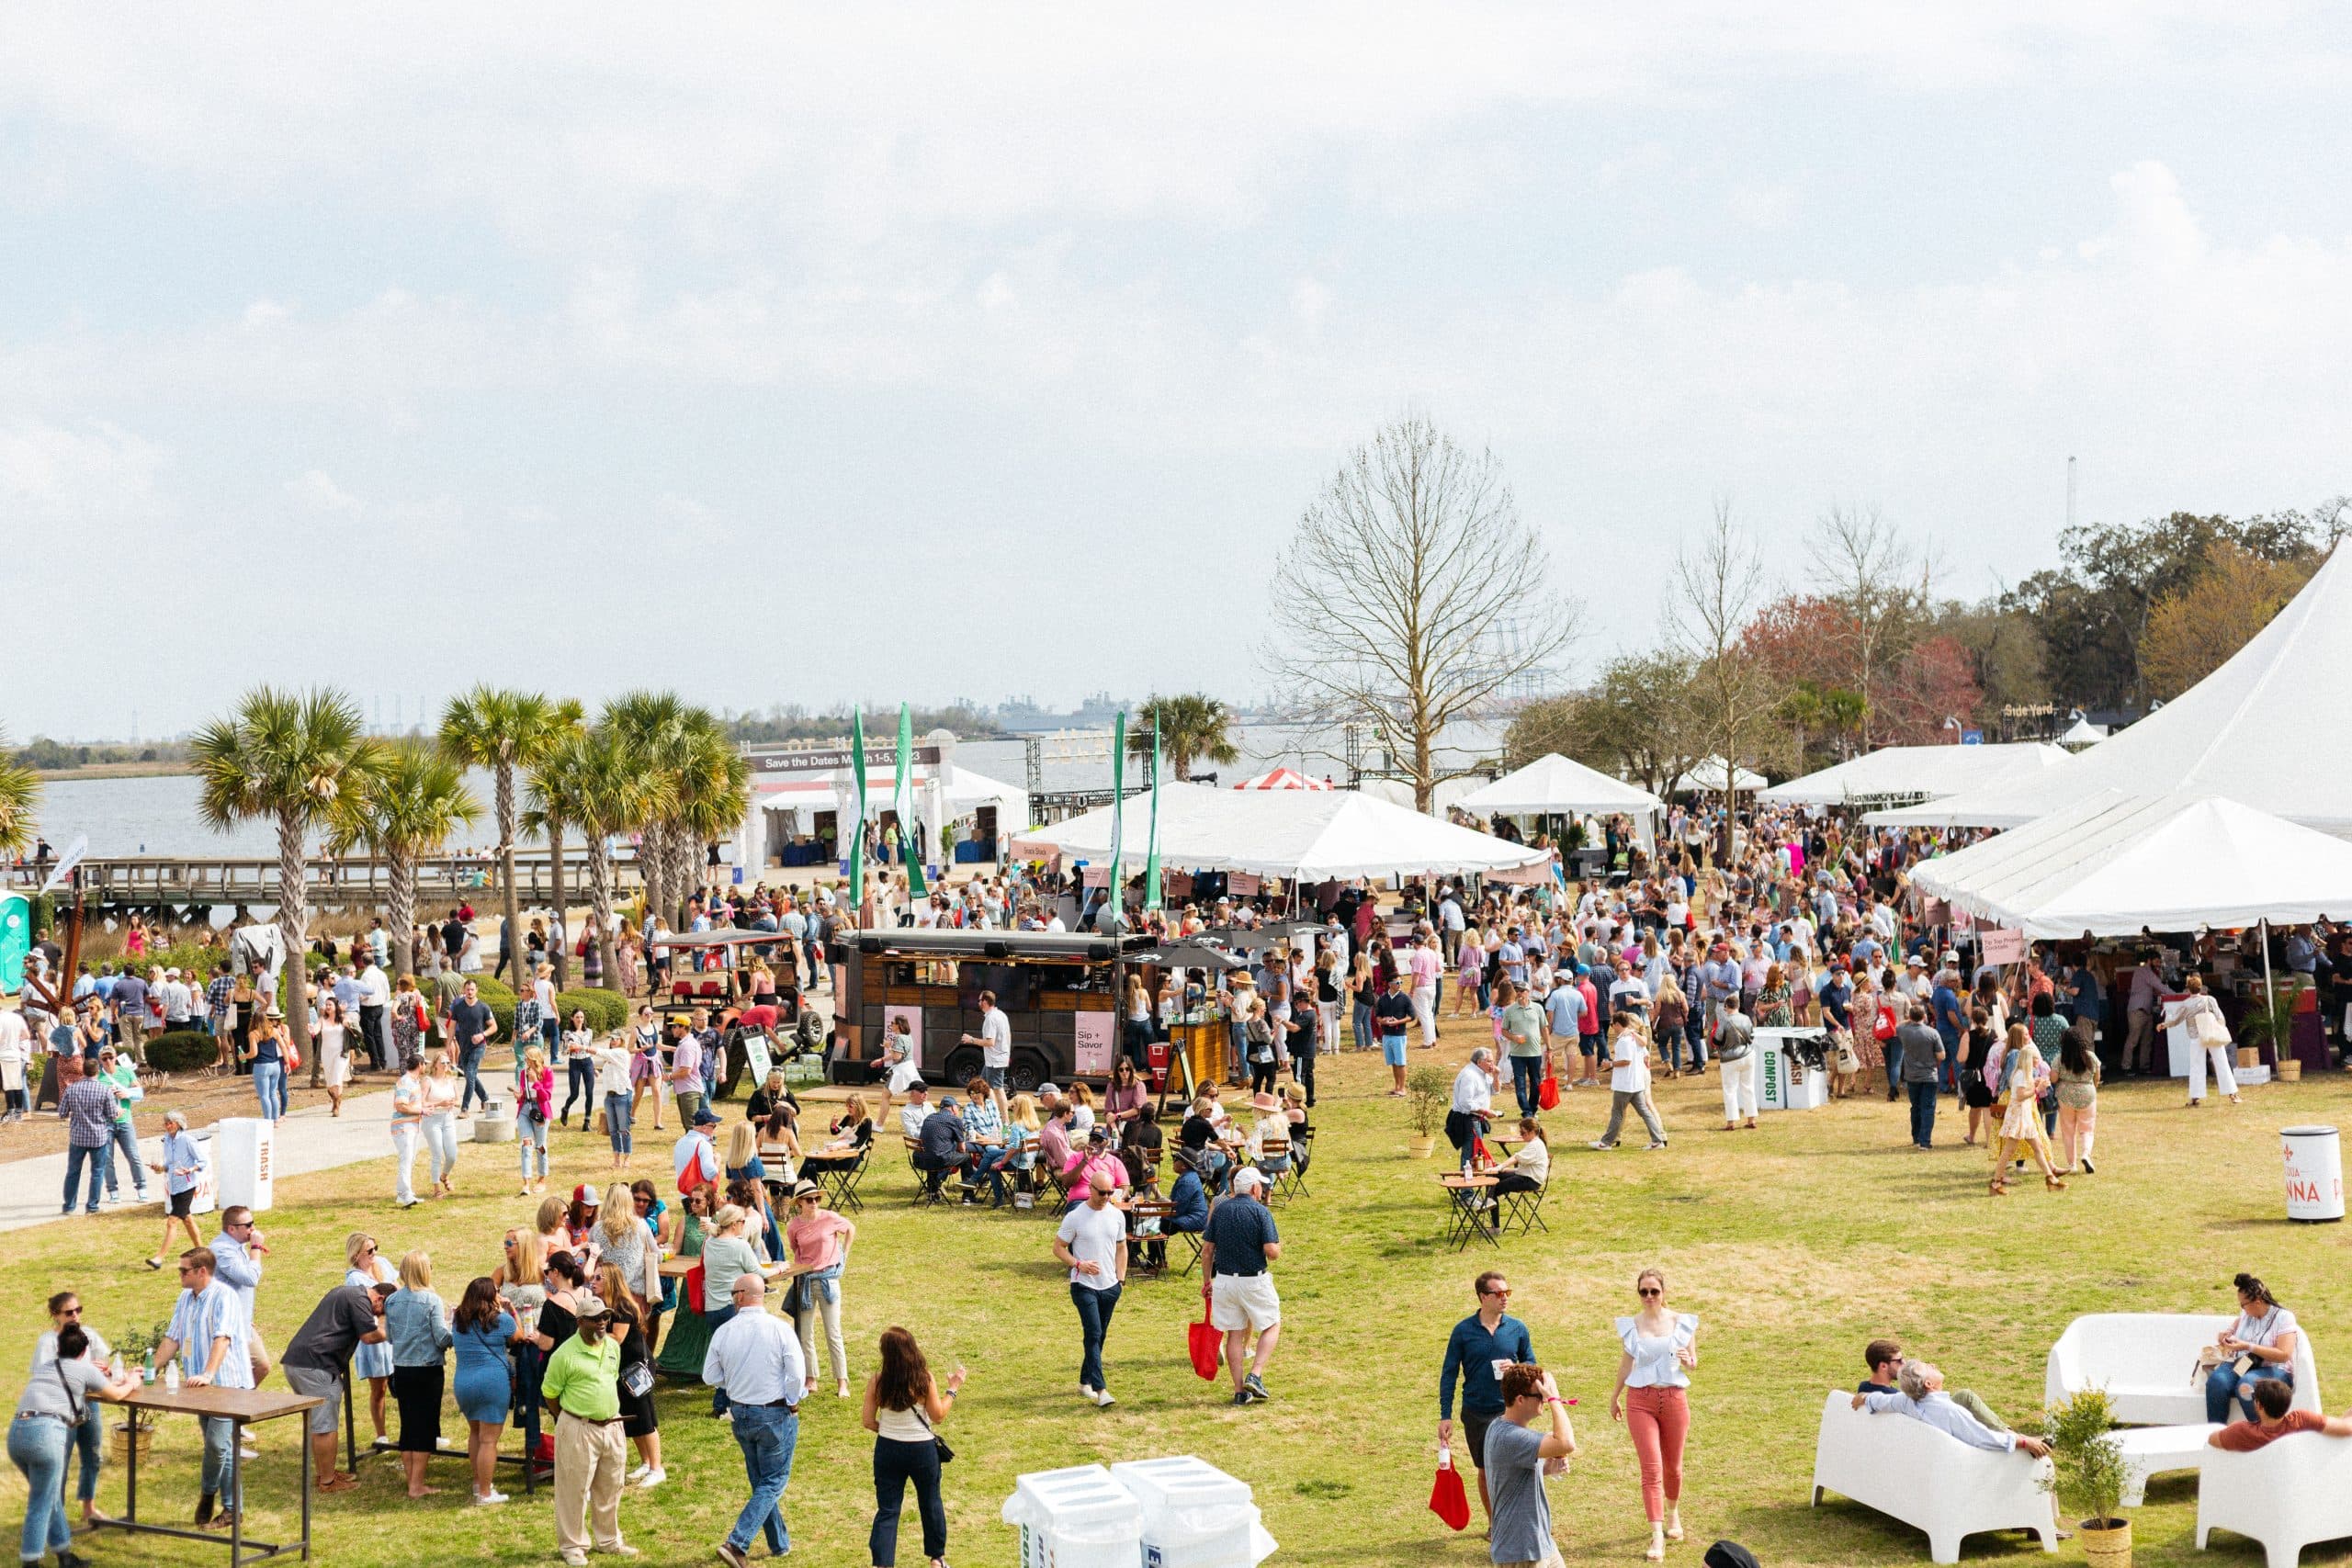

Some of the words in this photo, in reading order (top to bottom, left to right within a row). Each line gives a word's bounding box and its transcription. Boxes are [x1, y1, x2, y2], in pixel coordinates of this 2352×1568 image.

[2005, 704, 2029, 716] Side
[2030, 702, 2053, 716] Yard
[765, 758, 789, 768] Save
[791, 756, 808, 767] the
[810, 755, 839, 766] Dates
[874, 752, 893, 763] 1-5,
[1078, 1031, 1092, 1041] Sip
[1078, 1040, 1102, 1049] Savor
[1764, 1051, 1777, 1102] COMPOST
[1791, 1057, 1803, 1086] ASH
[260, 1139, 269, 1181] TRASH
